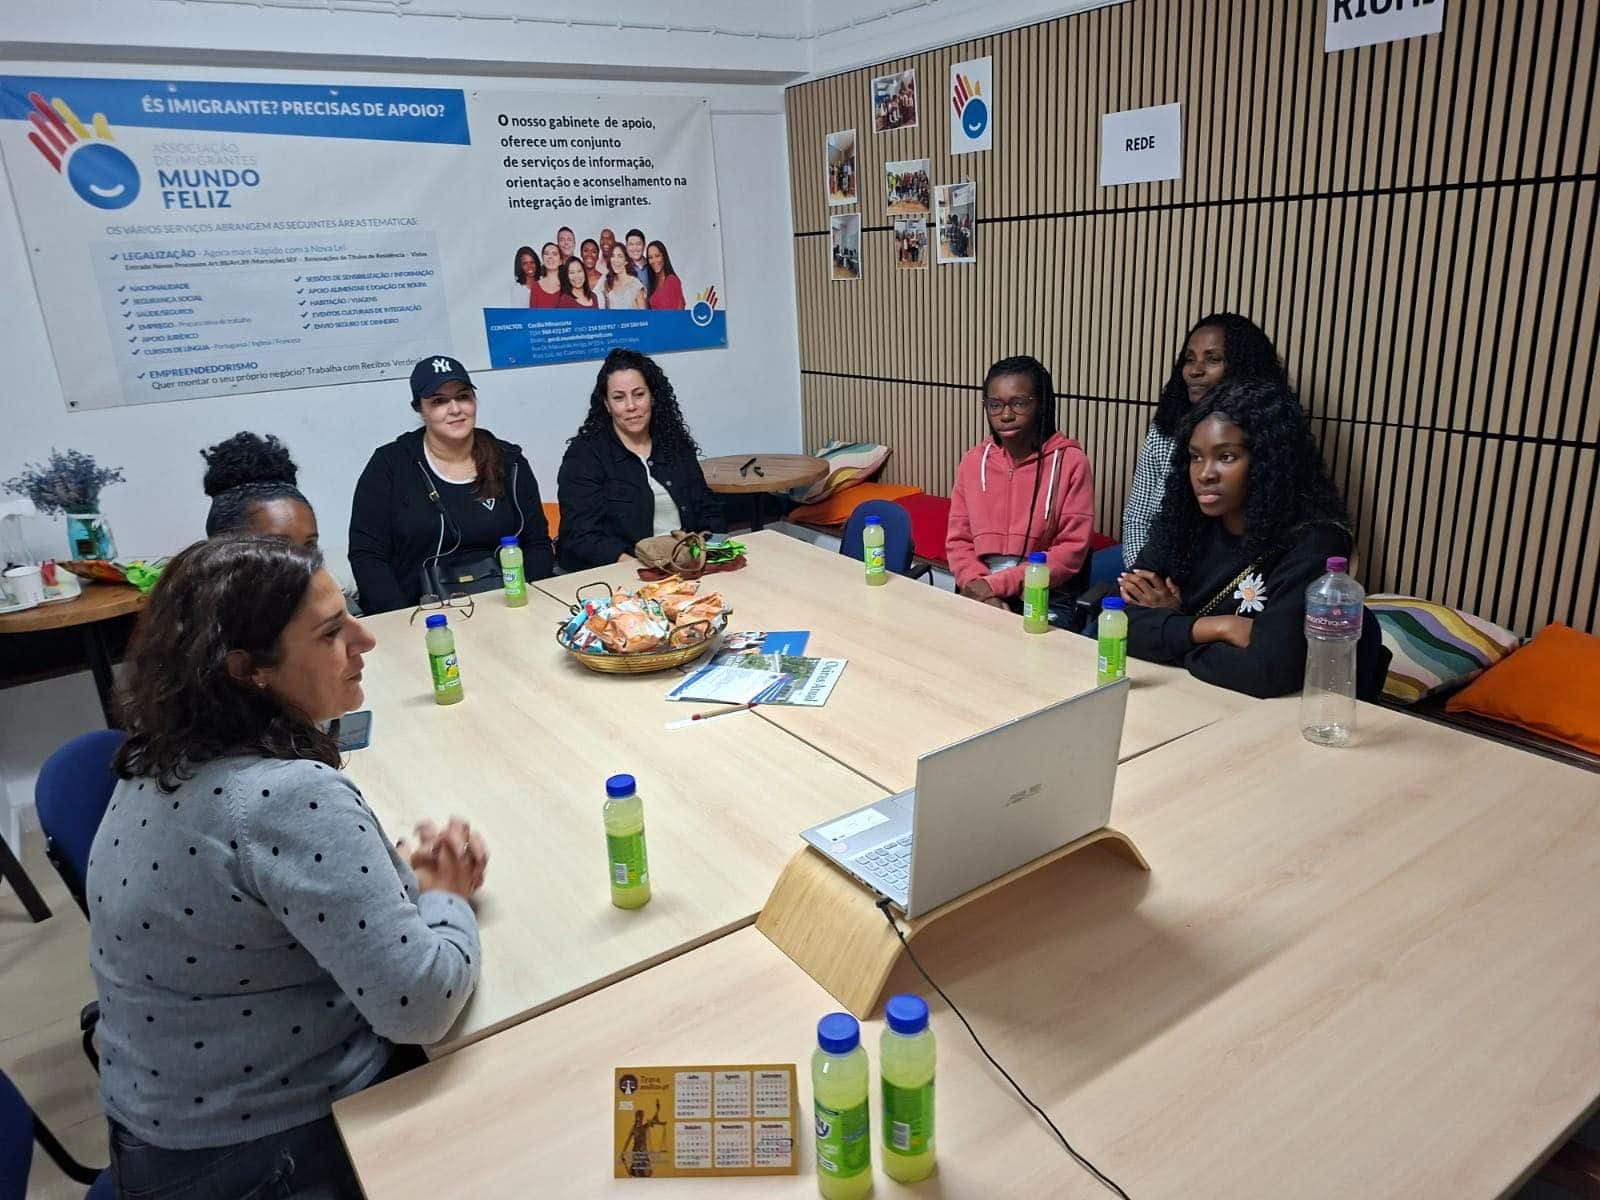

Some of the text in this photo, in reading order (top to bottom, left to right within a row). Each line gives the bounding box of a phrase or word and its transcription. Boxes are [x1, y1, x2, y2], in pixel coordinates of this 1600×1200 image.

[142, 95, 445, 117] ÉS IMIGRANTE? PRECISAS DE APOIO?
[498, 114, 656, 130] O nosso gabinete de apoio,
[153, 142, 240, 154] ASSOCIAÇÃO
[501, 136, 621, 151] oferece um conjunto
[1125, 135, 1156, 152] REDE
[154, 155, 257, 166] DE IMIGRANTES
[504, 156, 655, 170] de serviços de informação,
[158, 169, 260, 188] MUNDO
[506, 175, 688, 191] orientação e aconselhamento na
[162, 190, 232, 209] FELIZ
[508, 195, 652, 210] integração de imigrantes.
[106, 225, 122, 235] OS
[162, 223, 213, 234] SERVIÇOS
[215, 222, 271, 232] ABRANGEM
[273, 220, 286, 230] AS
[286, 218, 337, 230] SEGUINTES
[122, 248, 196, 261] LEGALIZAÇÃO
[310, 244, 333, 253] Nova
[150, 361, 258, 378] EMPREENDEDORISMO
[432, 358, 452, 374] NY
[152, 380, 175, 390] Quer
[178, 377, 210, 388] montar
[236, 372, 268, 384] próprio
[269, 368, 306, 380] negócio?
[307, 366, 342, 376] Trabalha
[343, 364, 361, 372] com
[362, 360, 392, 370] Recibos
